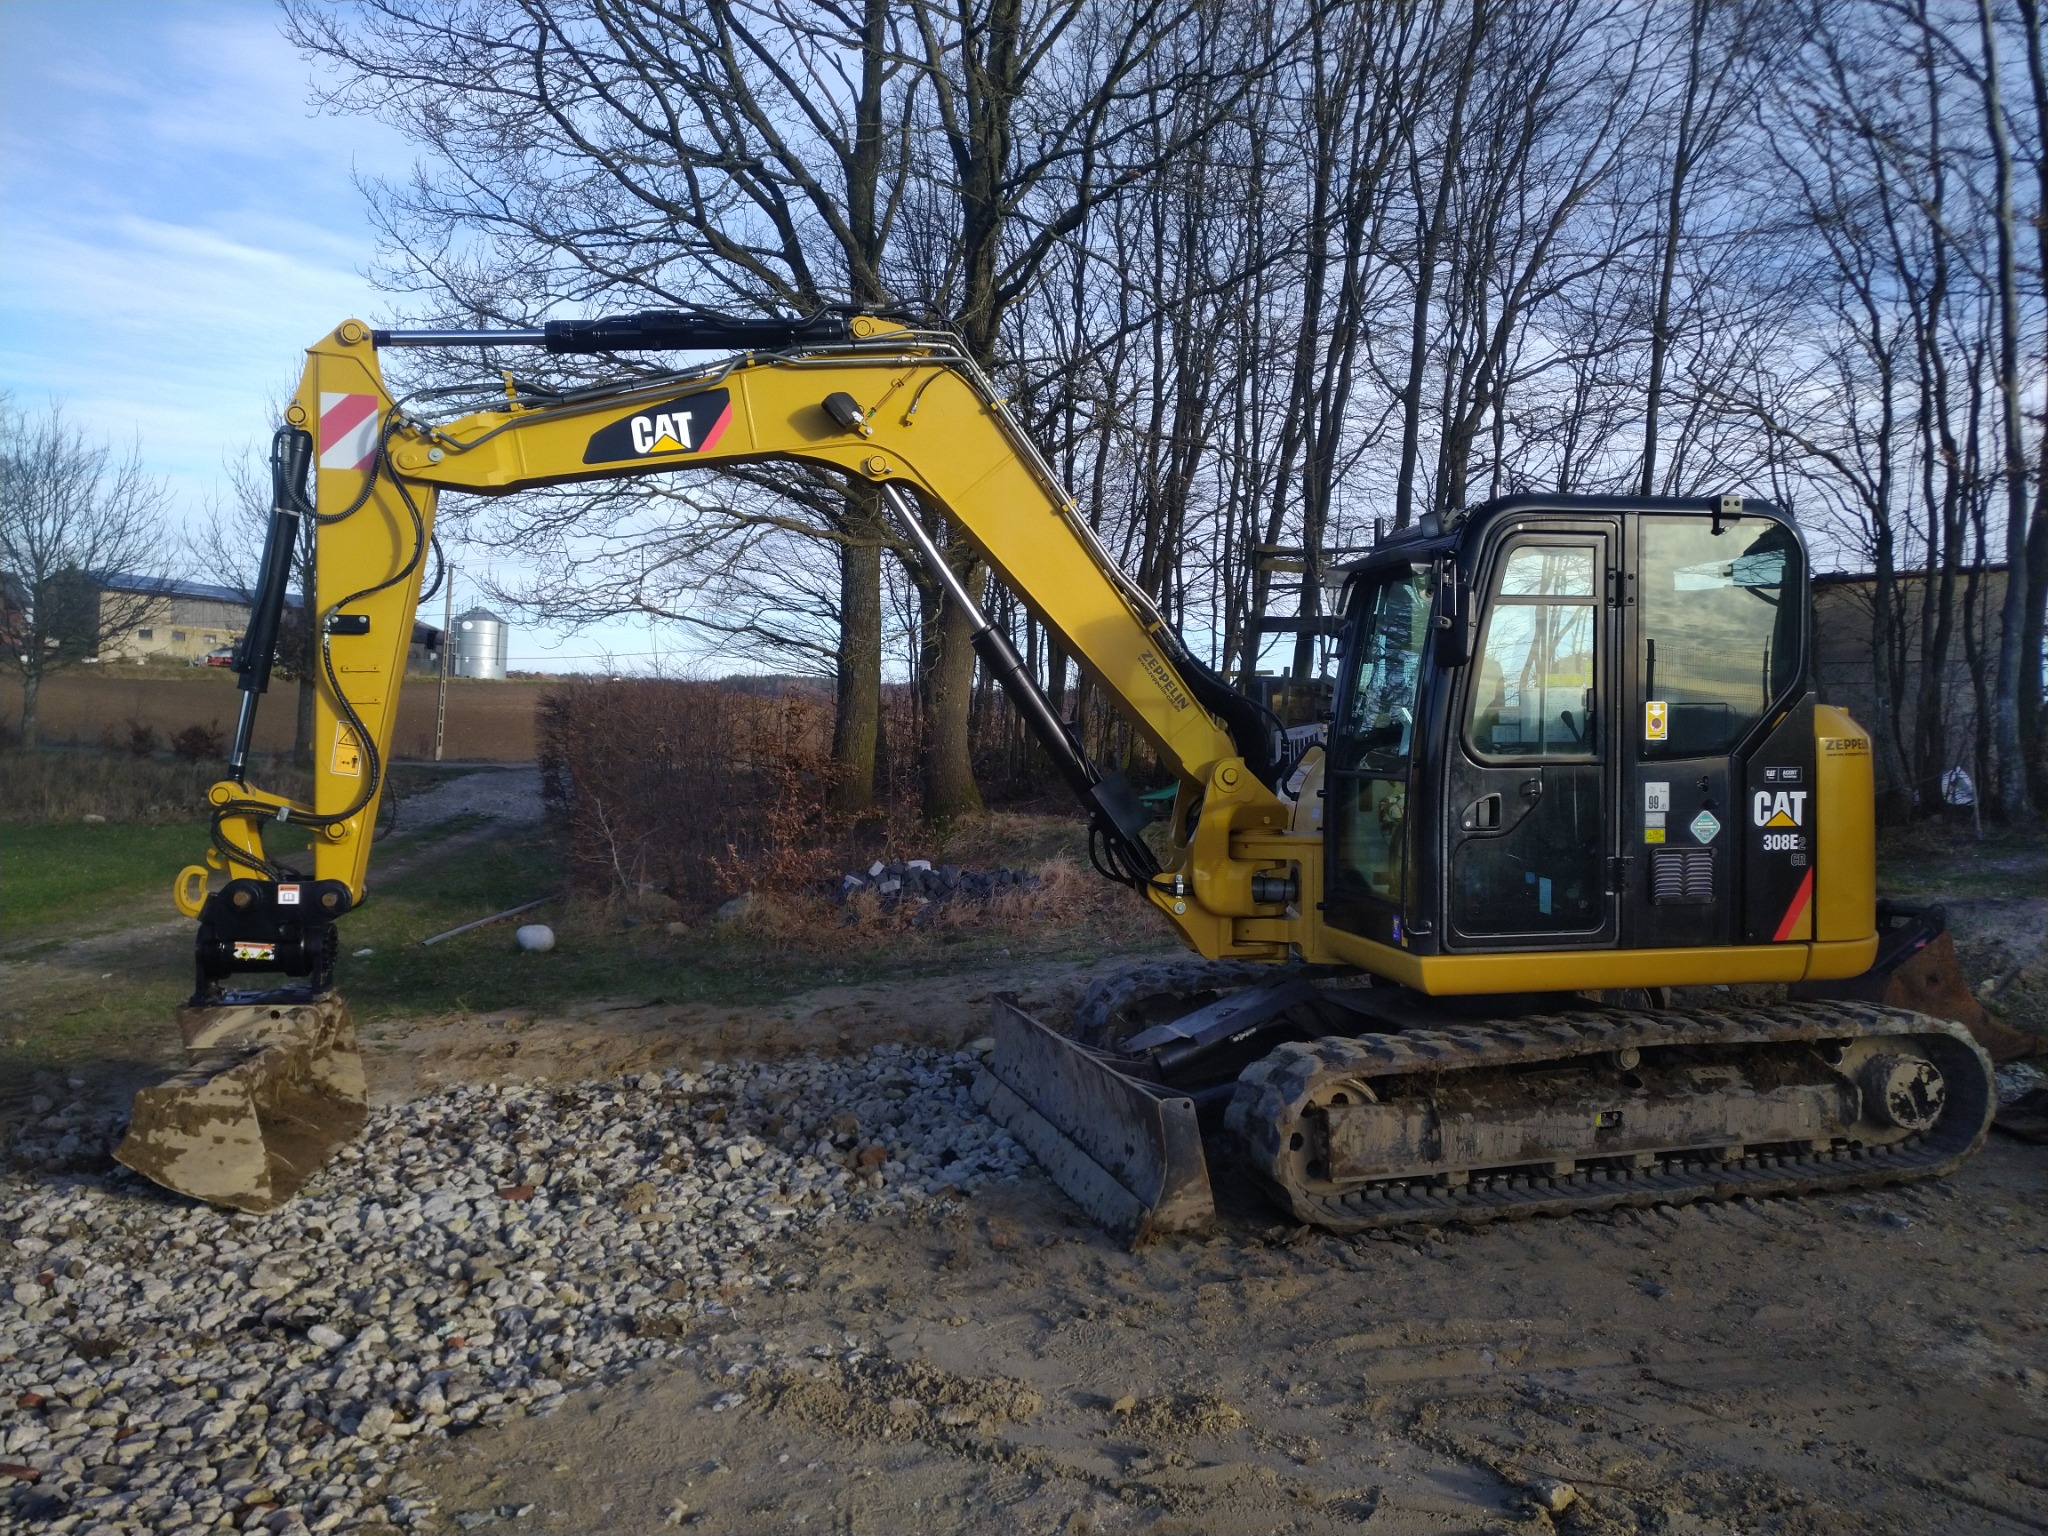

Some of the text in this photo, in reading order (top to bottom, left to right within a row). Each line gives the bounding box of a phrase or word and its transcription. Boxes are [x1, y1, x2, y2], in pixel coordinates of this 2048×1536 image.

[630, 411, 692, 453] CAT
[1140, 649, 1190, 710] ZEPPELIN
[1648, 795, 1659, 810] 99
[1754, 791, 1807, 827] CAT
[1790, 853, 1807, 867] CR
